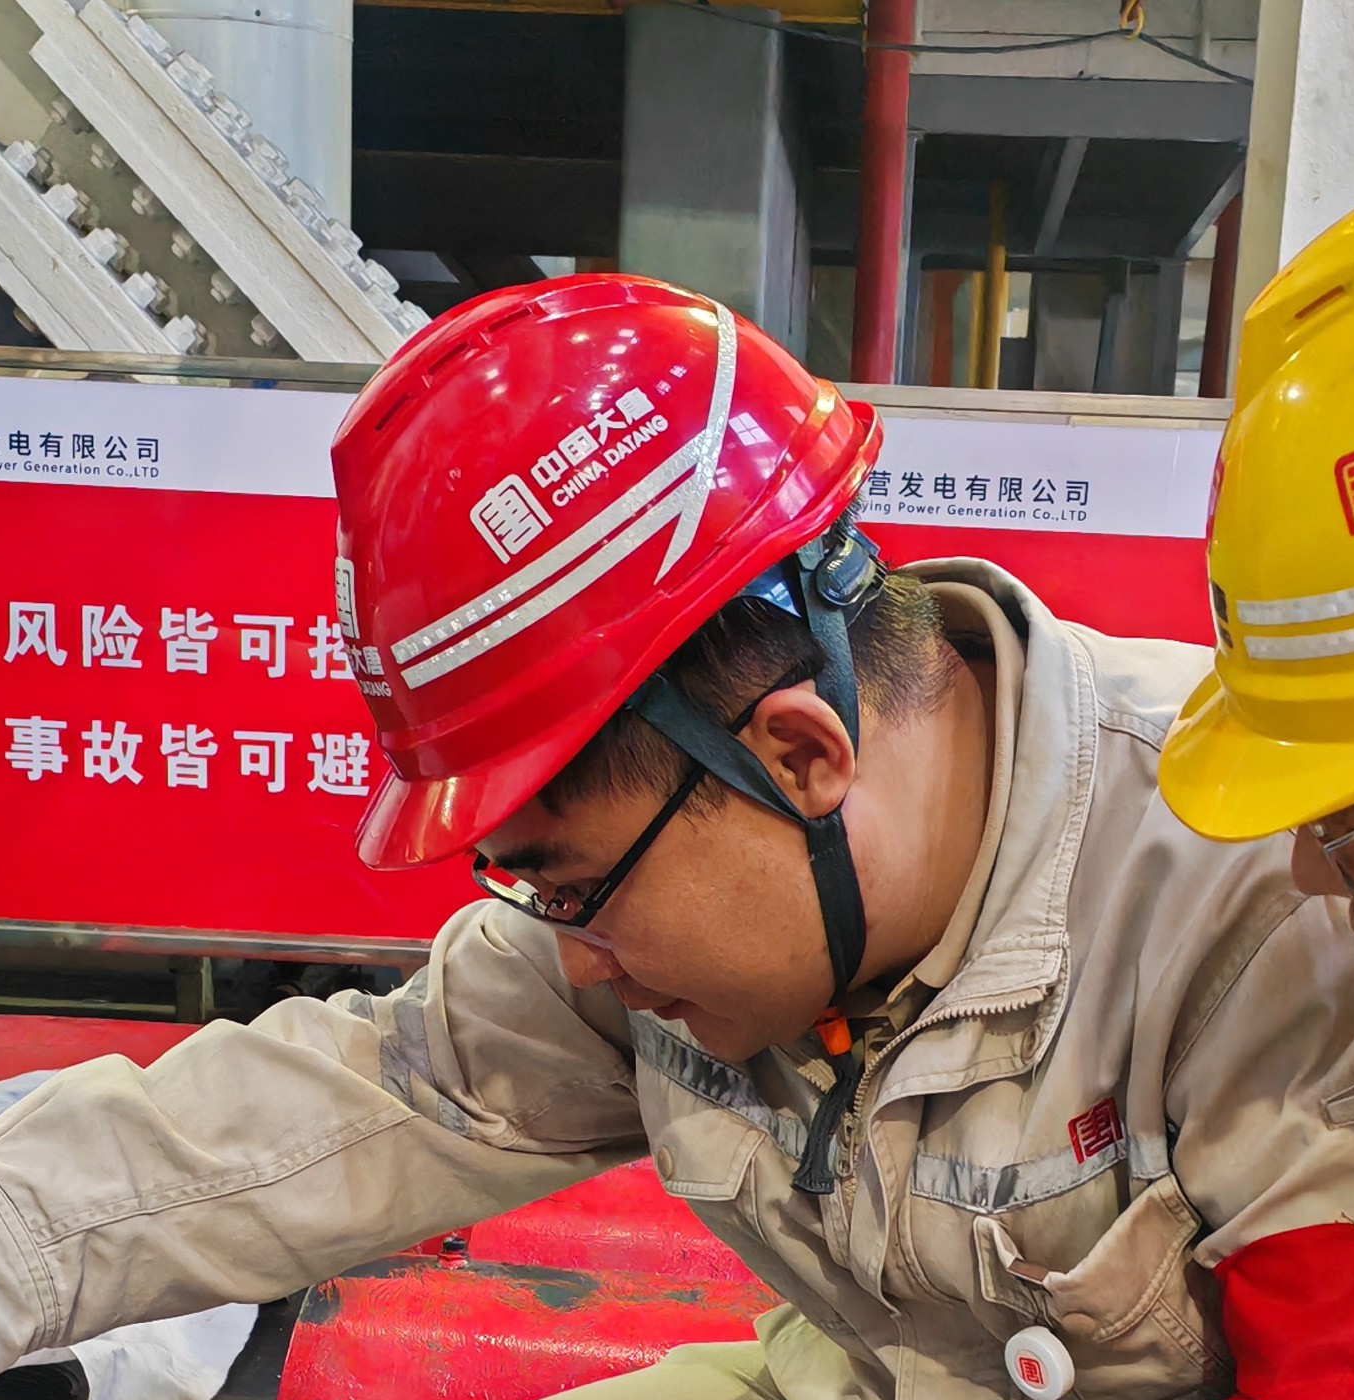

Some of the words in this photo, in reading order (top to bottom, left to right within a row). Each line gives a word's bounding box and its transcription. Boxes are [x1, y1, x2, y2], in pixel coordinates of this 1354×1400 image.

[530, 386, 656, 489] 中国大唐
[23, 460, 101, 476] Generation
[106, 464, 160, 479] Co.,LTD
[552, 460, 609, 507] CHINA
[602, 414, 669, 467] DATANG
[867, 470, 1090, 507] 营发电有限公司
[898, 501, 941, 515] Power
[947, 503, 1027, 519] Generation
[1032, 507, 1088, 523] Co.,LTD
